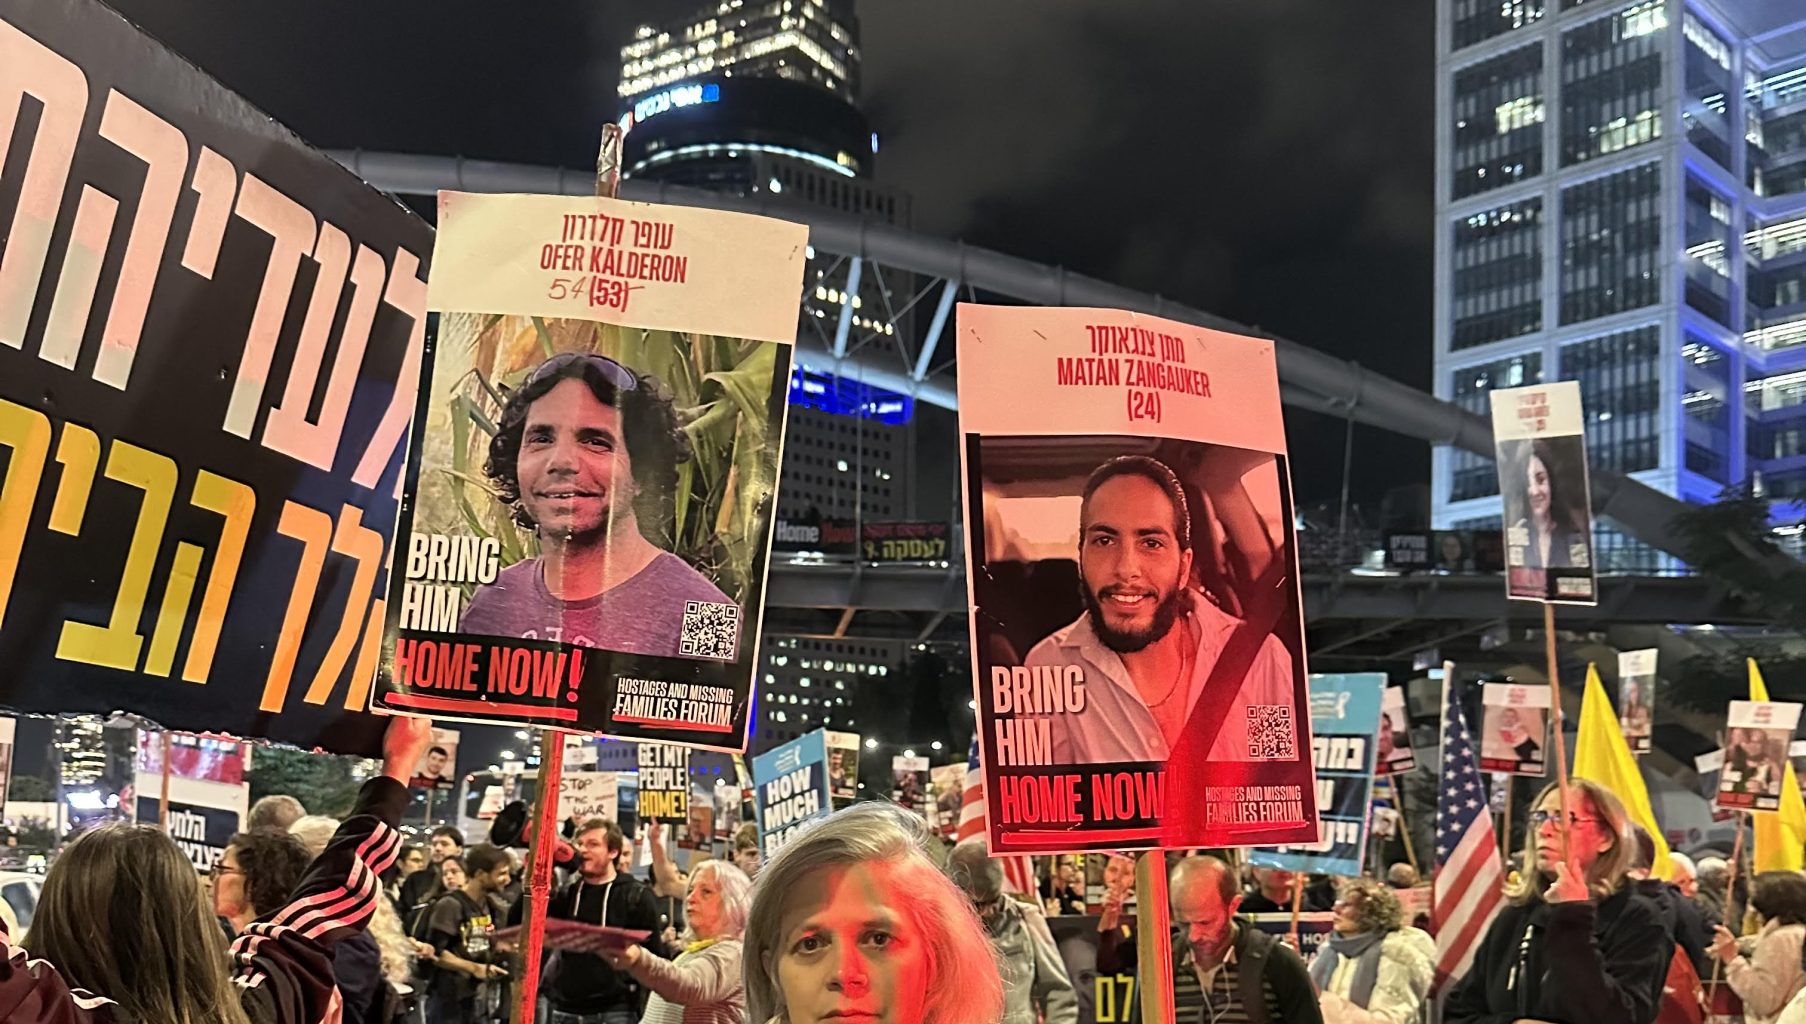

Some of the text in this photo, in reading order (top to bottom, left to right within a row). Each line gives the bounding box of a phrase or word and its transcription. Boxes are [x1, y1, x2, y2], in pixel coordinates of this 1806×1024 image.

[562, 213, 674, 250] עופר קלדרון
[540, 243, 687, 283] OFER KALDERON
[548, 276, 587, 300] 54
[589, 276, 629, 312] (53)
[1086, 325, 1185, 363] מתן צנגאוקר
[1057, 357, 1211, 398] MATAN ZANGAUKER
[1127, 389, 1161, 423] (24)
[776, 520, 819, 543] Home
[406, 532, 500, 584] BRING
[882, 539, 946, 560] לעסקה
[399, 583, 461, 633] HIM
[392, 638, 582, 702] HOME NOW!
[617, 677, 734, 704] HOSTAGES AND MISSING
[991, 665, 1085, 713] BRING
[614, 694, 732, 727] FAMILIES FORUM
[638, 743, 683, 767] GET MY
[994, 718, 1052, 766] HIM
[560, 778, 593, 793] STOP
[639, 767, 685, 790] PEOPLE
[767, 766, 811, 805] HOW
[1205, 786, 1245, 801] HOSTAGES
[1246, 786, 1263, 801] AND
[1264, 785, 1301, 801] MISSING
[573, 804, 605, 816] WAR
[639, 791, 687, 818] HOME!
[764, 789, 819, 831] MUCH
[1000, 774, 1083, 824] HOME
[1206, 801, 1304, 823] FAMILIES FORUM
[765, 825, 801, 857] BLO
[1095, 973, 1134, 1023] לם
